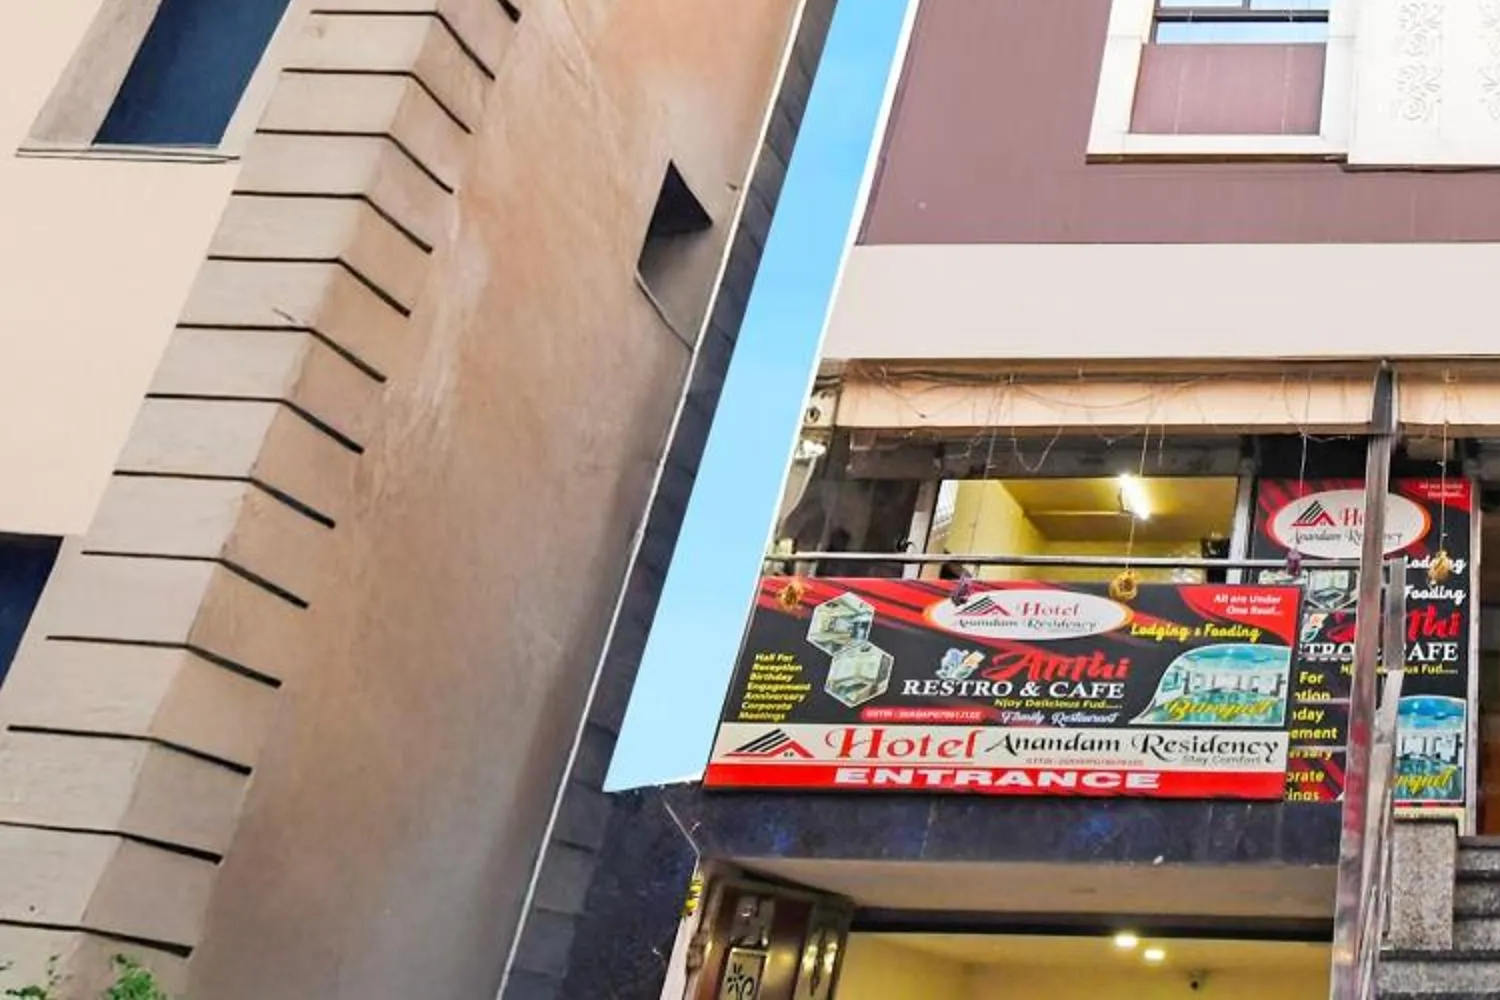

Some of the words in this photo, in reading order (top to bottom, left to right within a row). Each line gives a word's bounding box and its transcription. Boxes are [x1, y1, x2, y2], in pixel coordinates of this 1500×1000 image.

[1214, 594, 1227, 604] All
[1229, 595, 1248, 604] are
[1017, 601, 1080, 617] Hotel
[1226, 605, 1248, 615] One
[1130, 623, 1190, 642] Lodging
[1203, 623, 1261, 644] Fooding
[1405, 642, 1458, 661] AFE
[777, 653, 795, 662] For
[752, 663, 803, 673] Reception
[749, 672, 795, 683] Birthday
[1299, 671, 1324, 685] For
[747, 682, 812, 692] Engagement
[902, 679, 1013, 697] RESTRO
[1020, 681, 1041, 697] &
[1049, 681, 1125, 699] CAFE
[743, 692, 807, 703] Anniversary
[741, 702, 793, 712] Corporate
[825, 727, 986, 759] Hotel
[984, 732, 1120, 757] Anandam
[1131, 732, 1279, 764] Residency
[835, 767, 1161, 790] ENTRANCE
